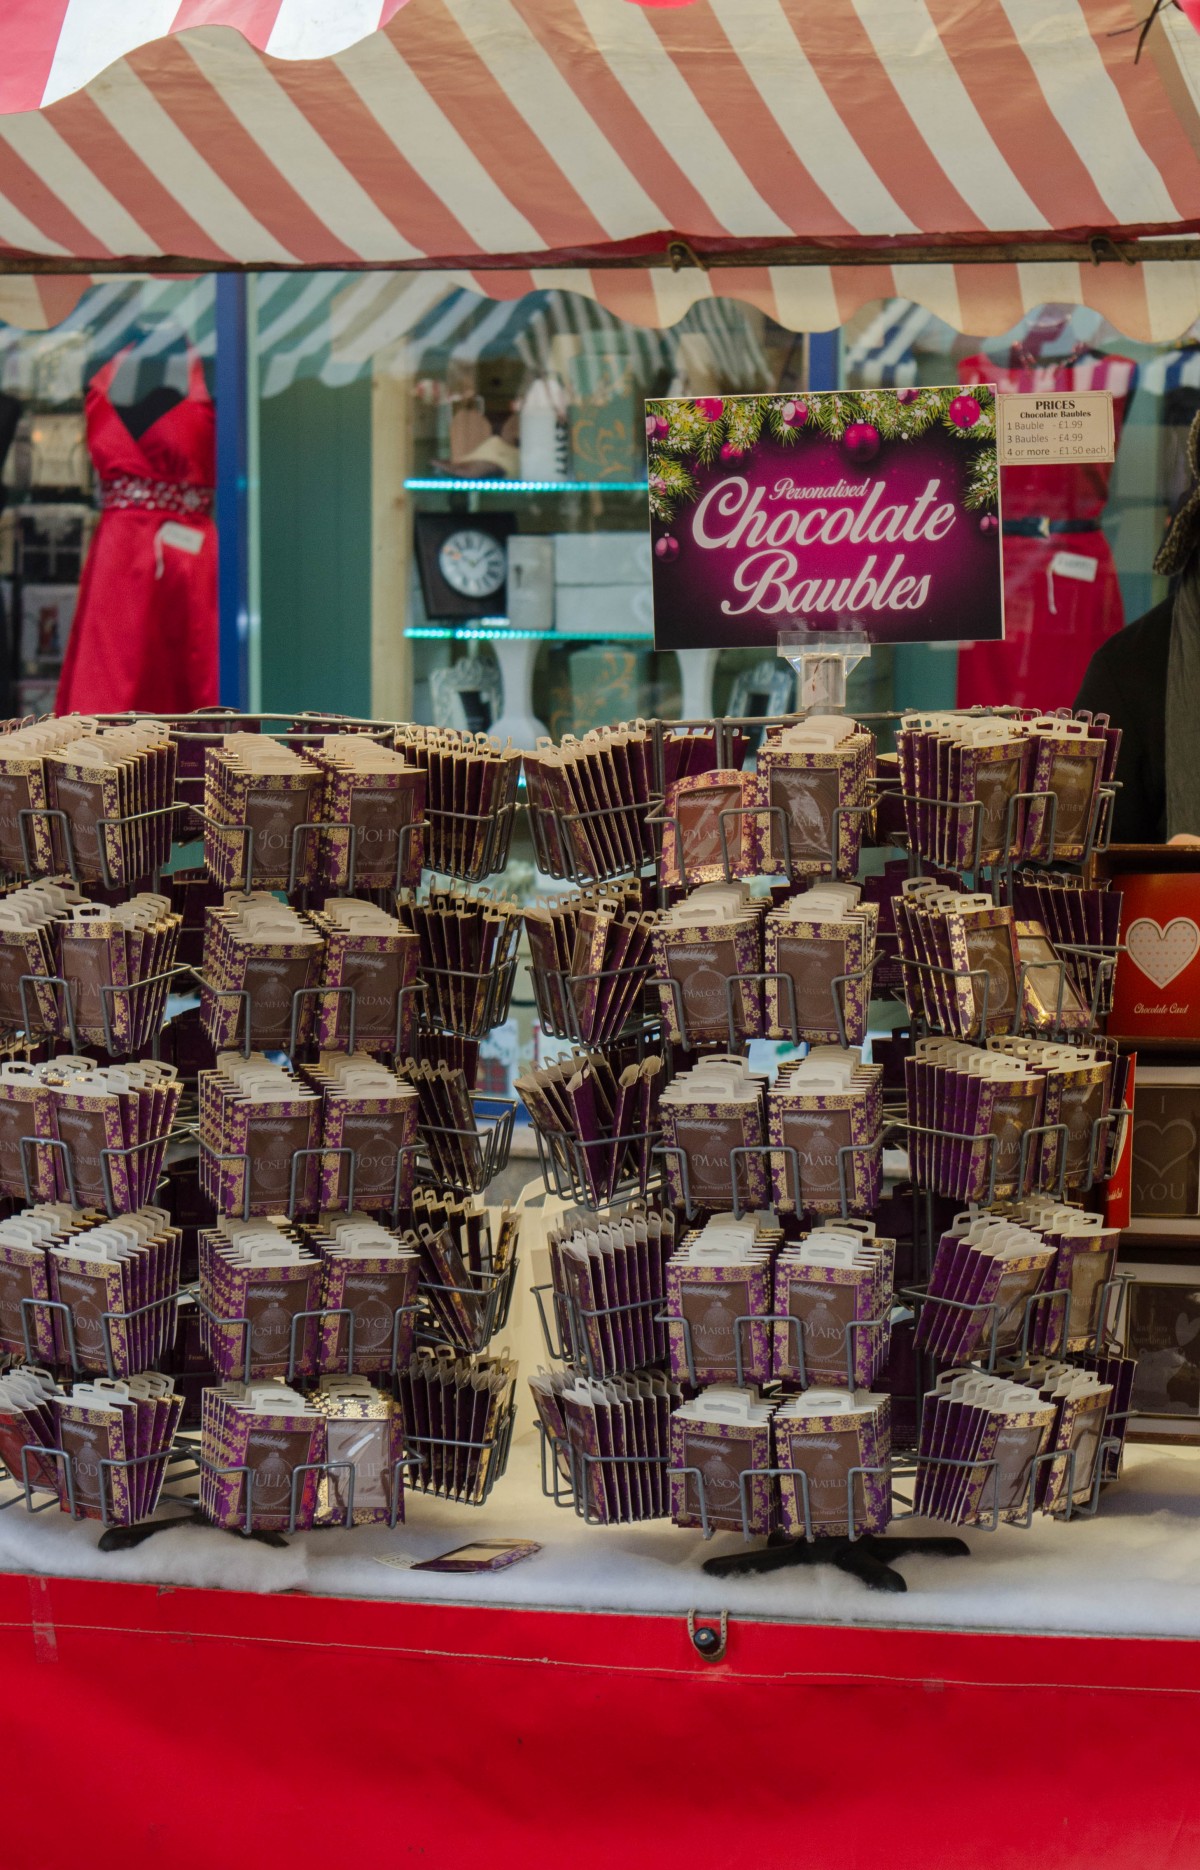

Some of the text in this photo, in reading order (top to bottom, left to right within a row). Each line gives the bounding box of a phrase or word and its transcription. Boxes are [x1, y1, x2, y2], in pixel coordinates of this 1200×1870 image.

[1035, 399, 1076, 411] PRICES
[1020, 410, 1092, 419] Chocolate Baubles
[1007, 422, 1012, 431] 1
[1014, 421, 1045, 431] Bauble
[1058, 420, 1083, 430] £1.99
[1007, 435, 1013, 444] 3
[1015, 434, 1049, 444] Baubles
[1059, 433, 1084, 443] £4.99
[1007, 448, 1013, 456] 4
[1026, 448, 1050, 456] more
[1059, 446, 1084, 455] £1.50
[1085, 445, 1107, 455] each
[768, 477, 871, 501] Personalised
[691, 476, 957, 550] Chocolate
[720, 548, 933, 616] Baubles
[357, 825, 400, 844] JOHN
[1133, 1002, 1190, 1014] Chocolate Card
[254, 1158, 293, 1173] JOSEP
[1136, 1183, 1185, 1200] YOU
[354, 1317, 391, 1330] OYCE
[801, 1321, 845, 1340] MARY
